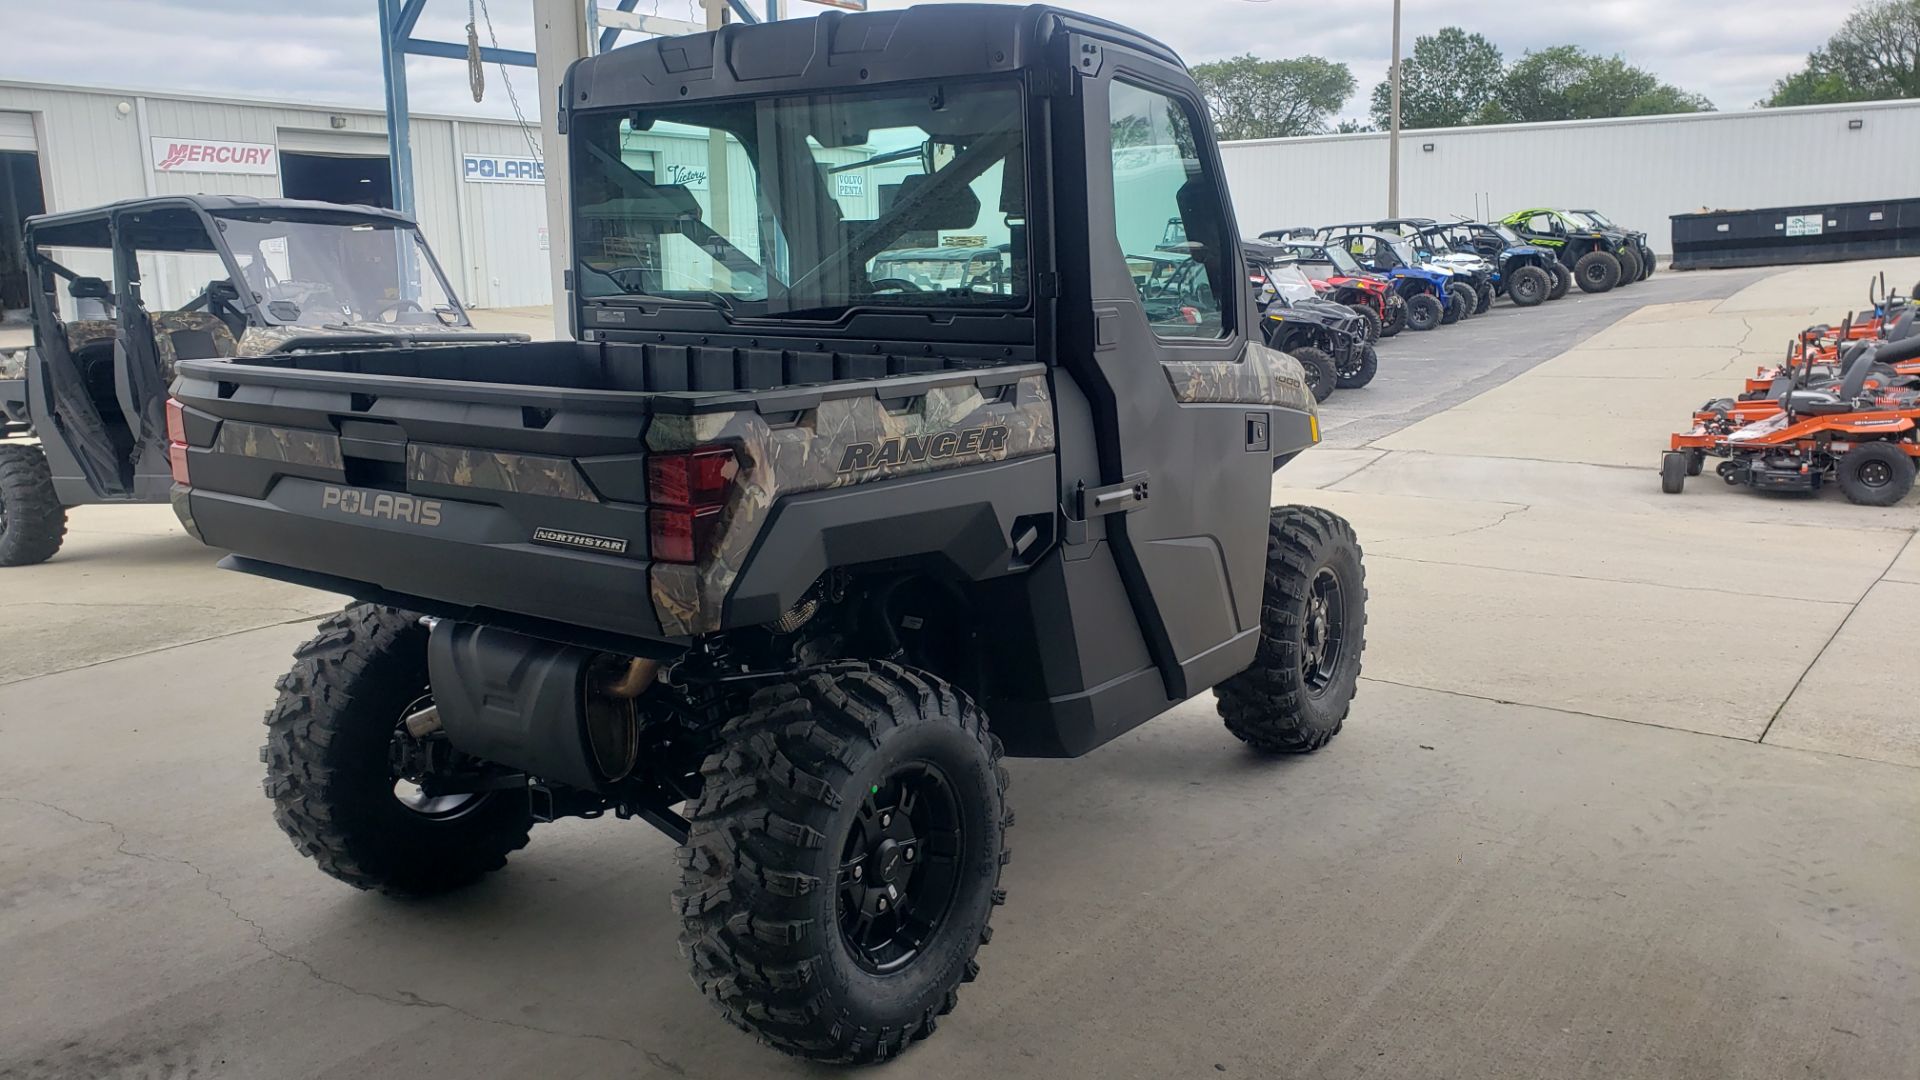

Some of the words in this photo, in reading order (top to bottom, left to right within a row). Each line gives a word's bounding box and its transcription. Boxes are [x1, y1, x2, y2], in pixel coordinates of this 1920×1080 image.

[160, 143, 272, 168] MERCURY
[667, 165, 707, 185] Victory
[839, 175, 863, 185] VOLVO
[839, 185, 863, 195] PENTA
[837, 425, 1009, 474] RANGER
[322, 486, 442, 526] POLARIS
[537, 530, 622, 550] NORTHSTAR
